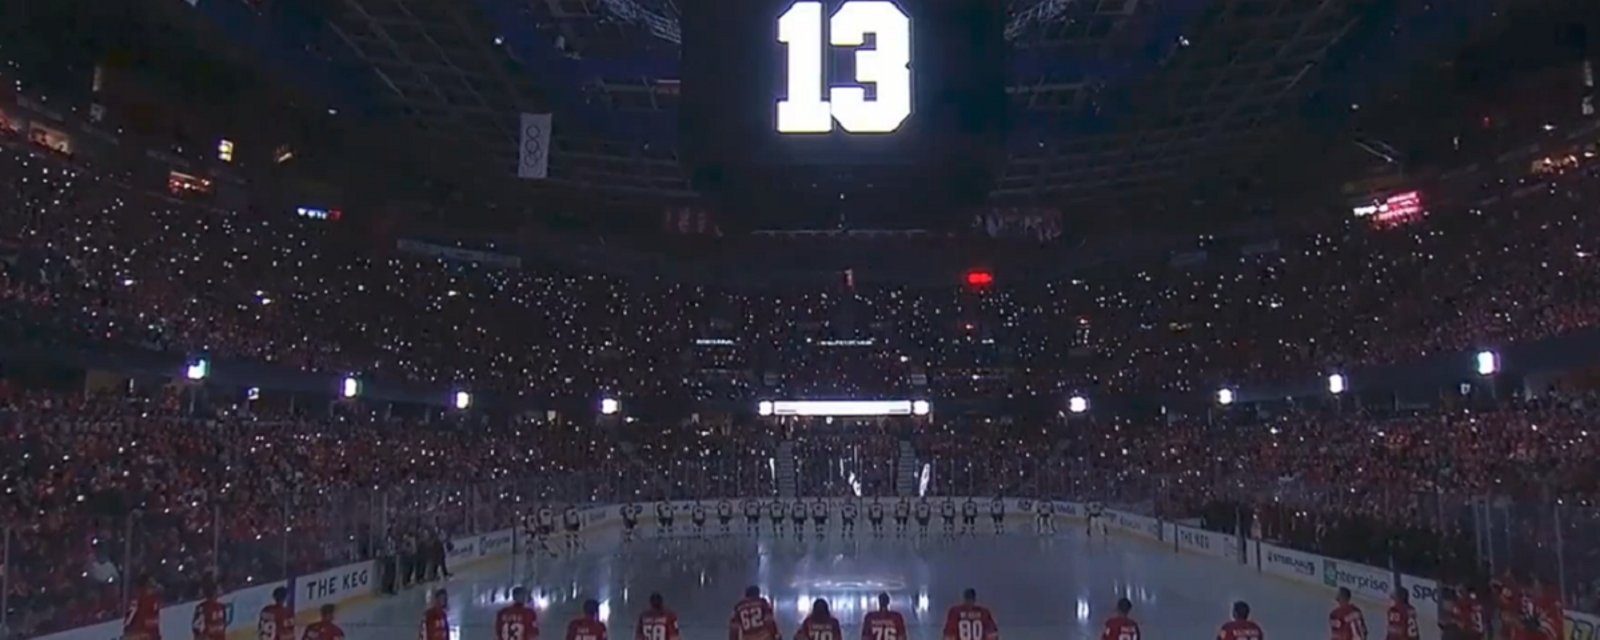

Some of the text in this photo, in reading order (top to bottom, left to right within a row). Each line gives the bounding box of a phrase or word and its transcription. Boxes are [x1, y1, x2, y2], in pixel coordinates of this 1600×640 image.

[777, 0, 912, 133] 13
[307, 569, 368, 600] THE KEG
[740, 606, 764, 632] 62
